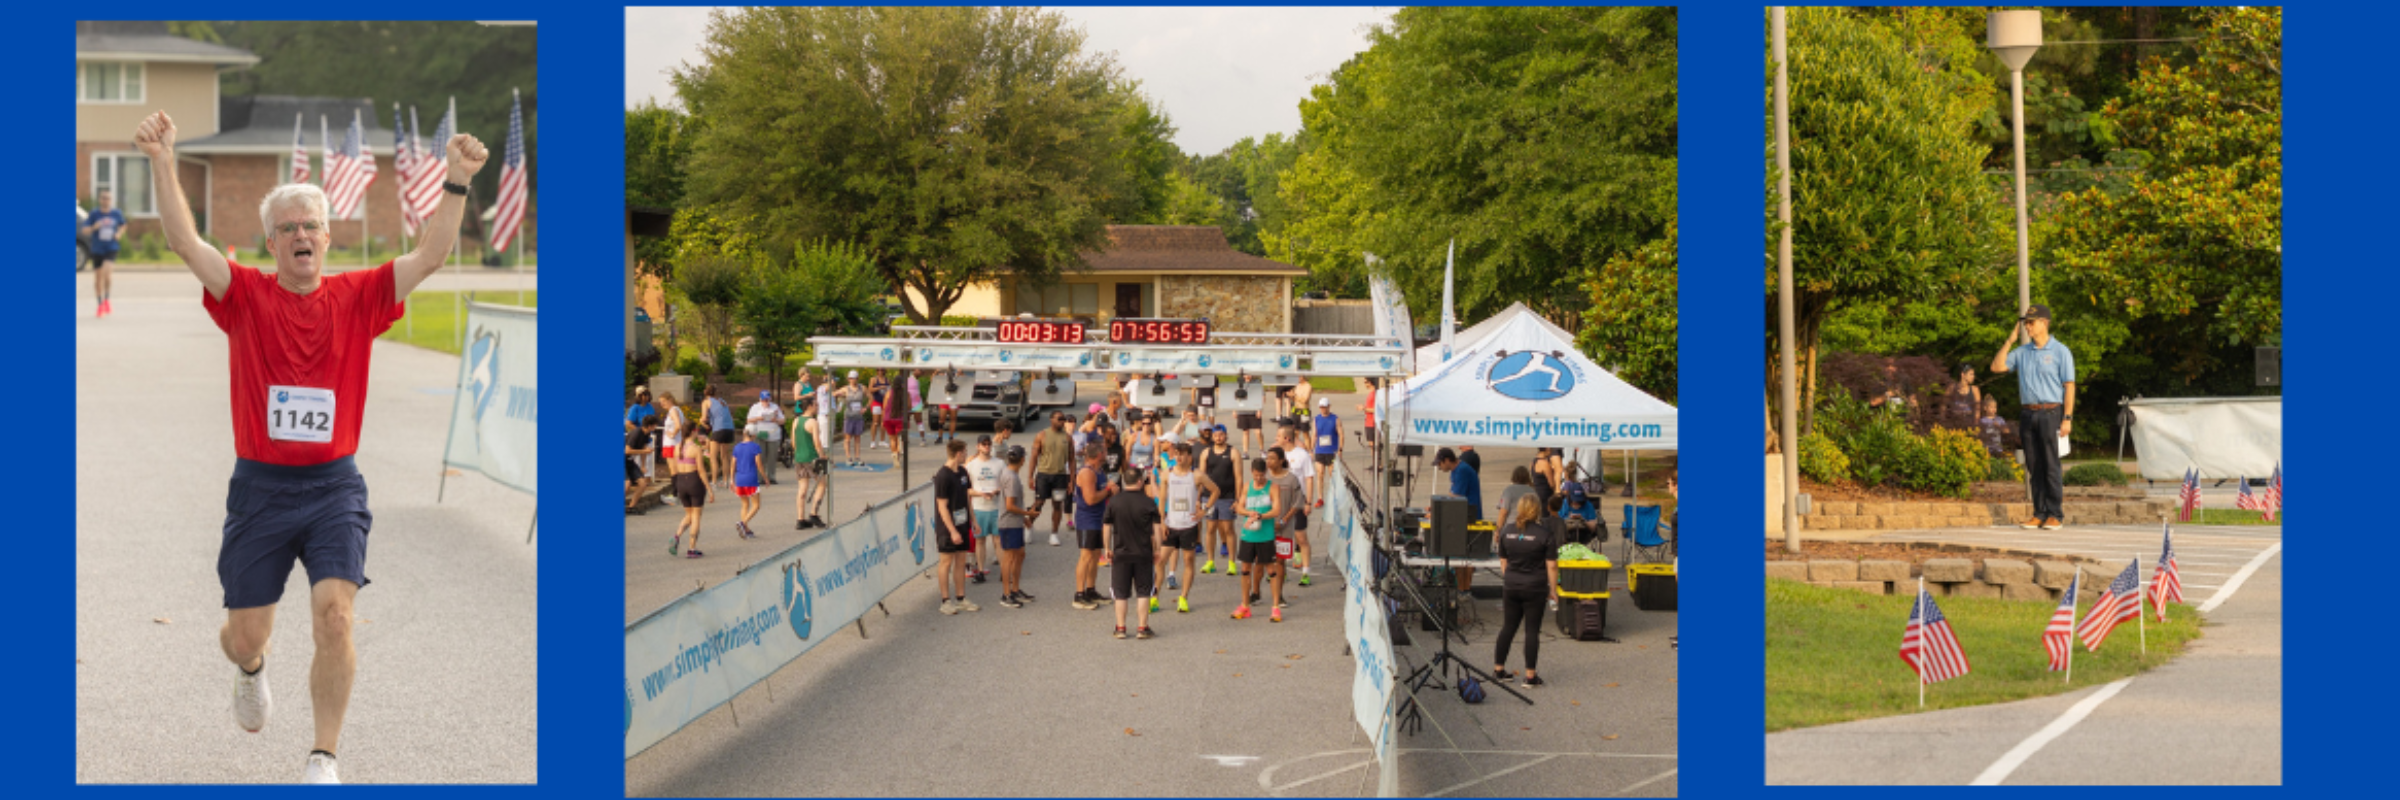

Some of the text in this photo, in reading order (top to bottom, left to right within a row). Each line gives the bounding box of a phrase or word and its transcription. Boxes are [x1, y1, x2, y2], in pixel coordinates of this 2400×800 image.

[1000, 322, 1082, 343] 00:03:13
[1111, 322, 1207, 341] 07:56:53
[273, 409, 330, 432] 1142
[1413, 416, 1662, 442] www.simplytiming.com
